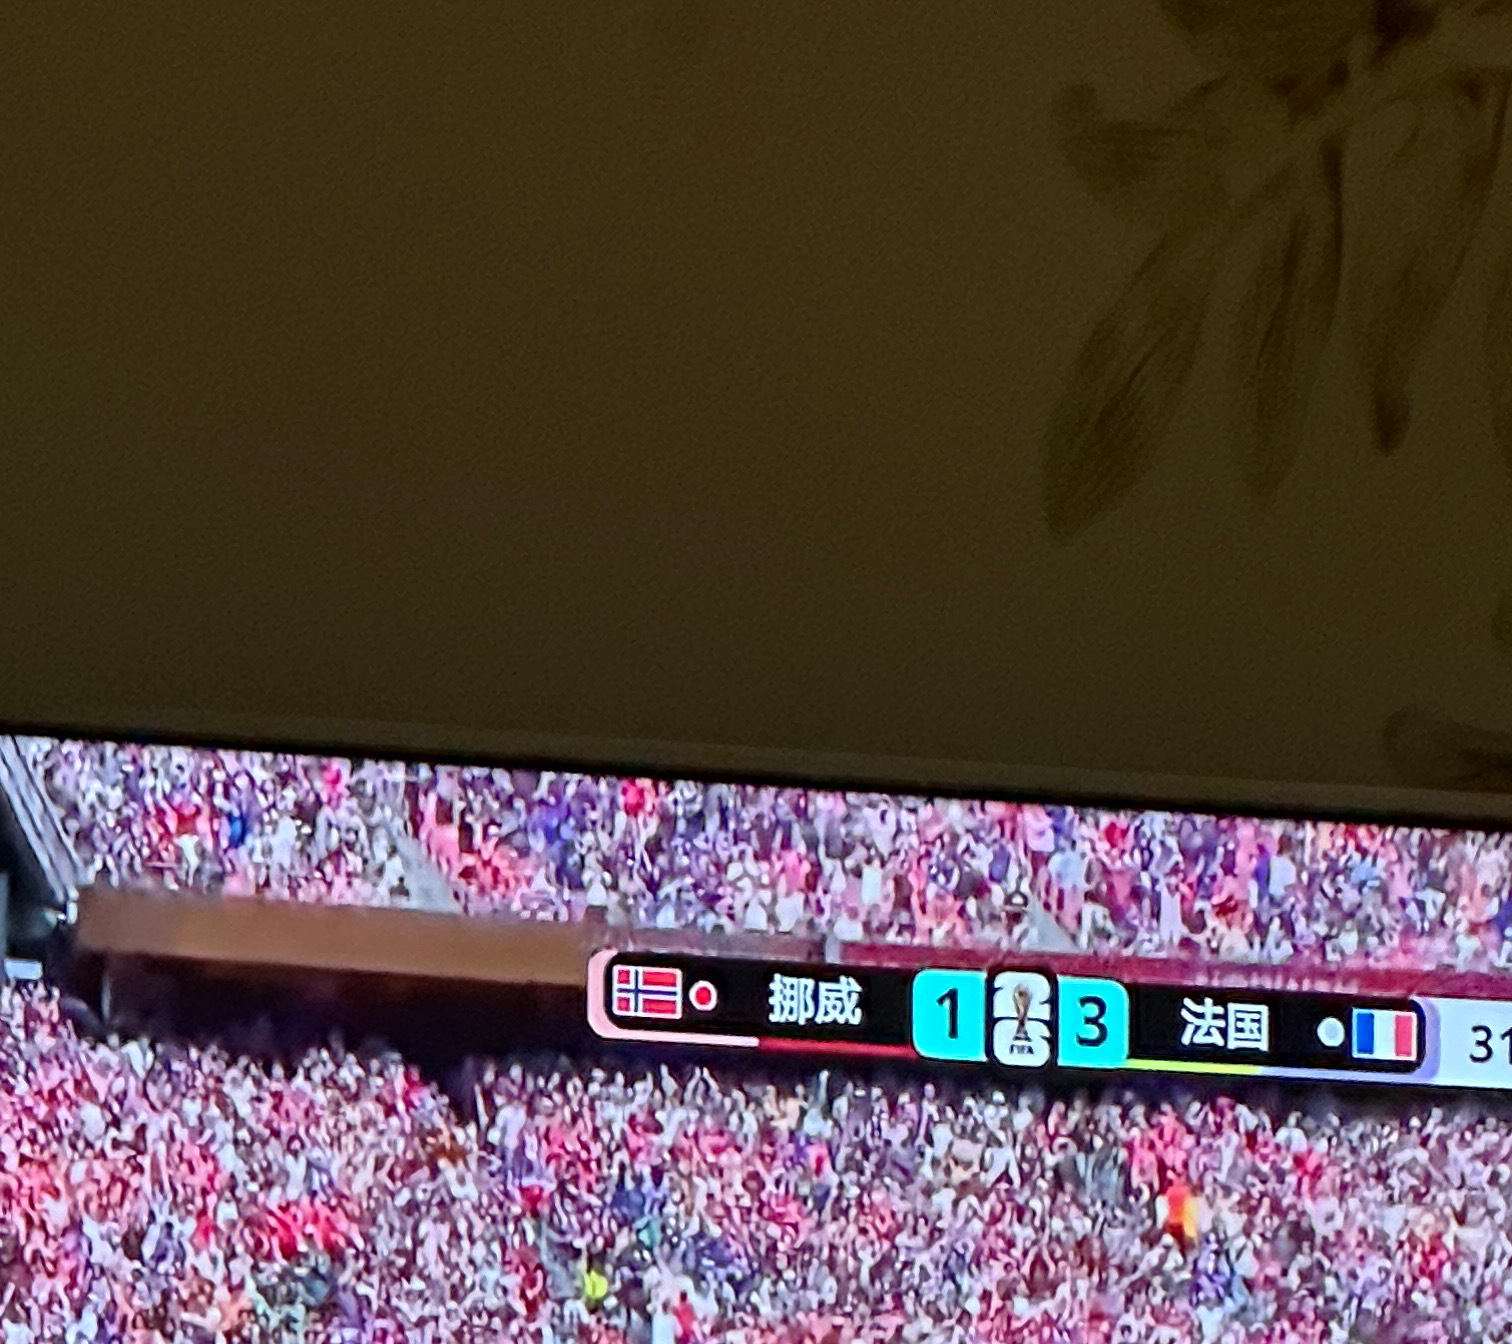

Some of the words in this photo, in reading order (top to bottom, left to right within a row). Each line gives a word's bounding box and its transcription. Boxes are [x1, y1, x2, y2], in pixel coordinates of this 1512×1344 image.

[767, 972, 864, 1027] 挪威
[936, 987, 960, 1040] 1
[1075, 995, 1108, 1048] 3
[1179, 996, 1270, 1052] 法国
